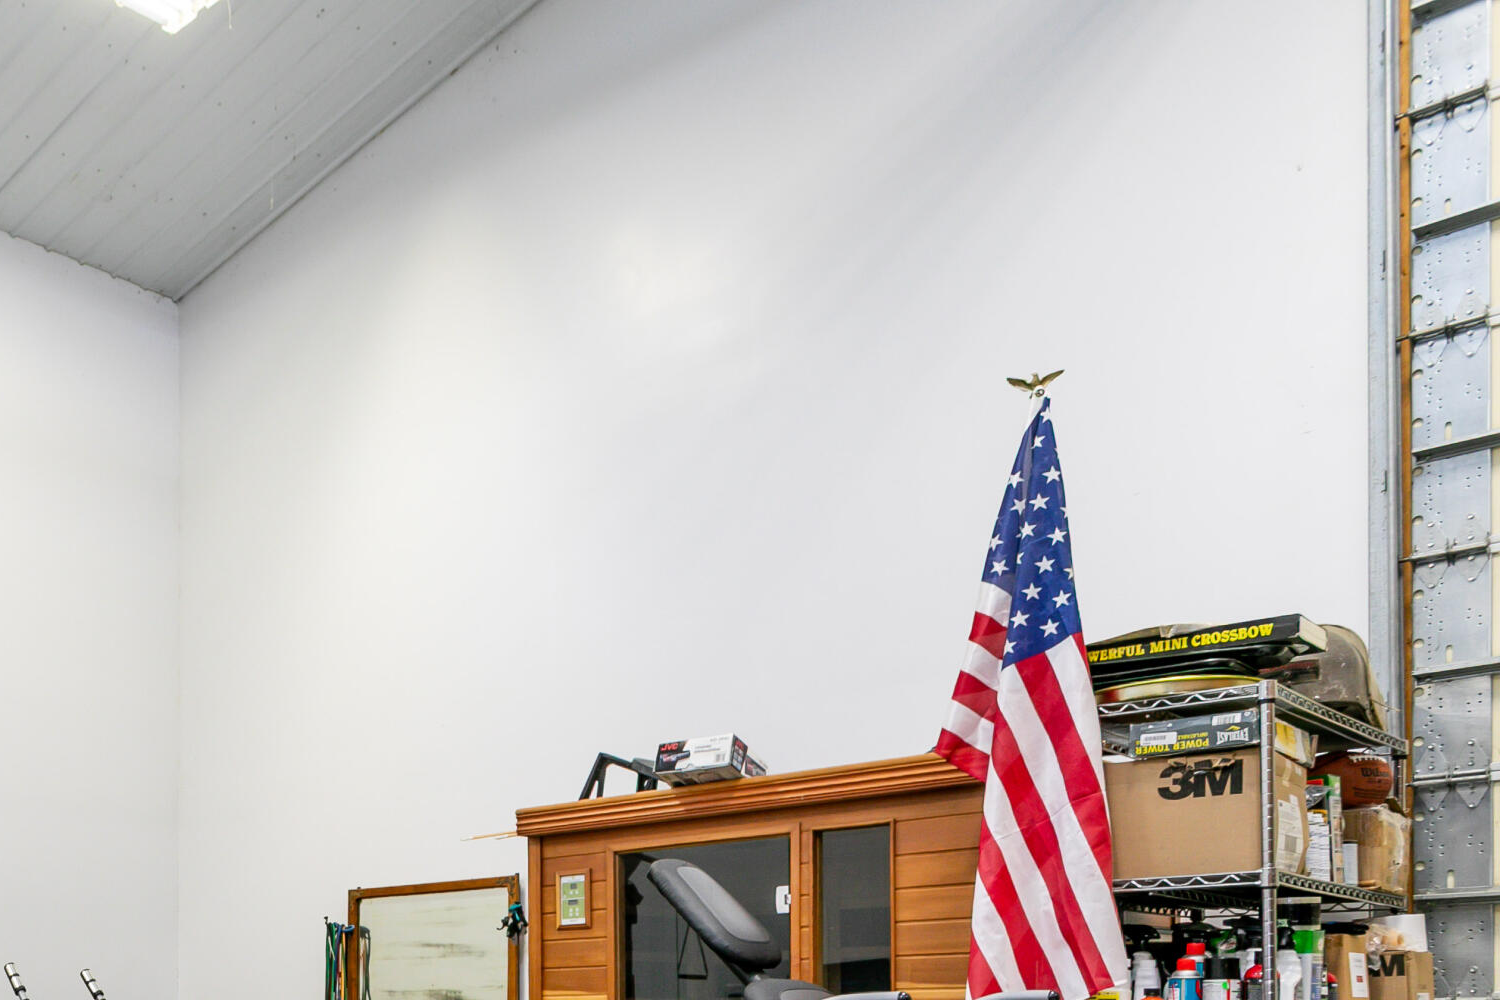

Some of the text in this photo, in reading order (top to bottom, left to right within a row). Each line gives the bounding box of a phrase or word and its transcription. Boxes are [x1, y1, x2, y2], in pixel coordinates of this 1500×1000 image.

[1087, 623, 1274, 663] WERFUL MINI CROSSBOW
[660, 742, 678, 752] JVC
[1135, 737, 1209, 755] POWER TOWER
[1157, 759, 1243, 800] 3M
